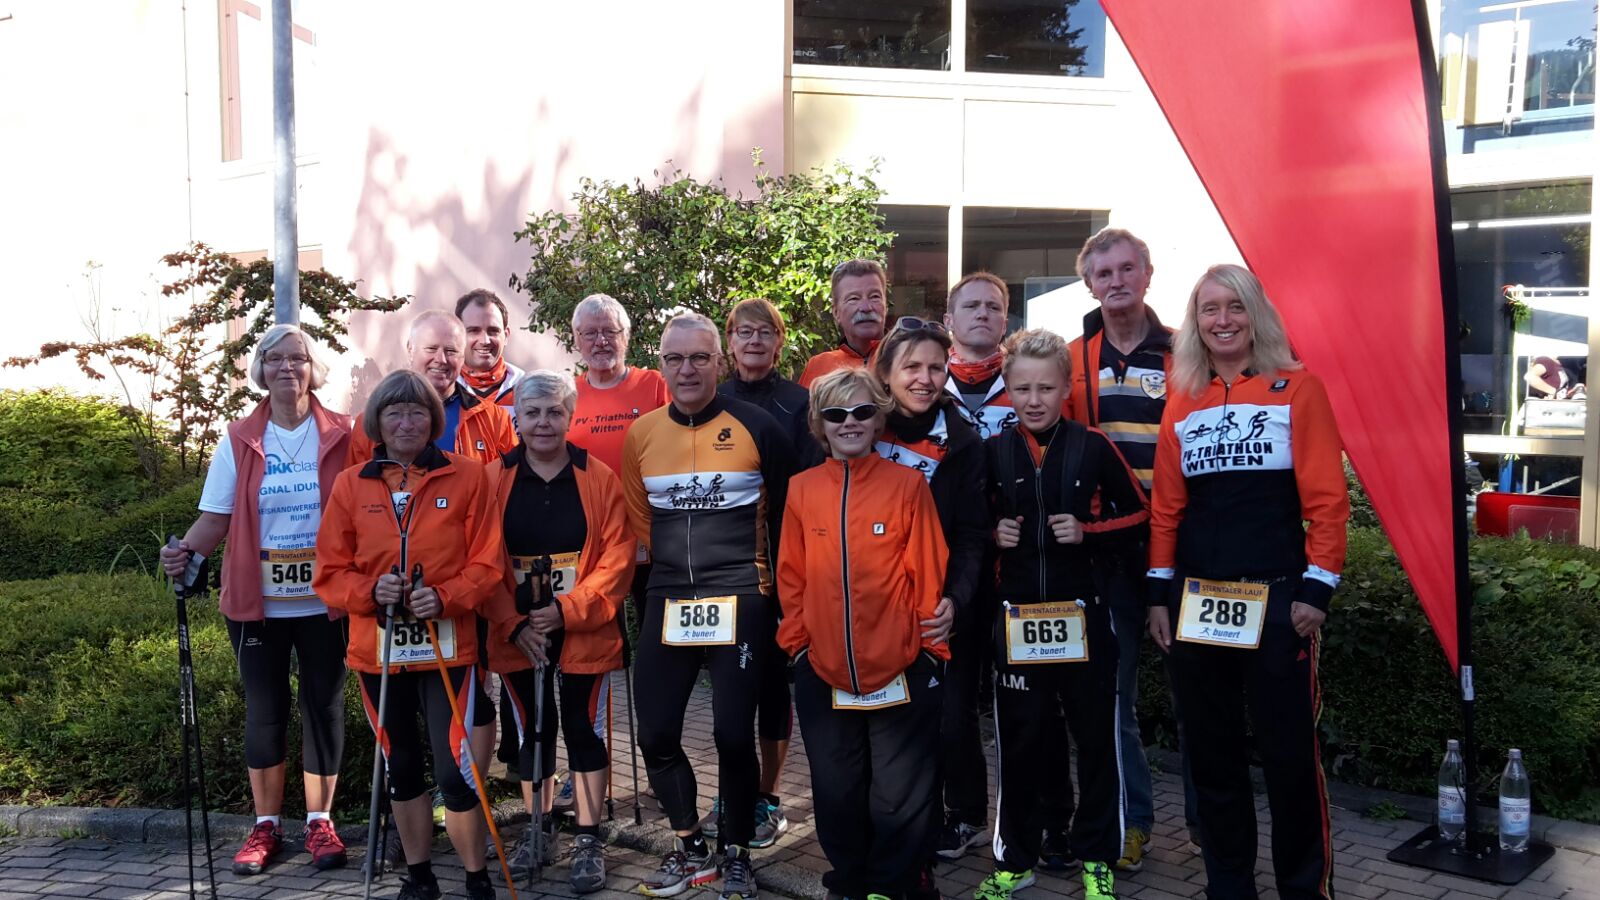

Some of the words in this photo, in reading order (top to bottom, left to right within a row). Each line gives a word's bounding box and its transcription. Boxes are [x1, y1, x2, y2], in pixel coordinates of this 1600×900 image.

[590, 424, 624, 434] Witten
[1186, 455, 1264, 472] WITTEN
[258, 484, 291, 496] GNAL
[290, 513, 310, 522] RUHR
[272, 563, 312, 583] 546
[680, 605, 719, 627] 588
[1199, 598, 1247, 627] 288
[1023, 619, 1068, 644] 663
[1212, 628, 1240, 639] bunert
[1040, 647, 1066, 655] bunert
